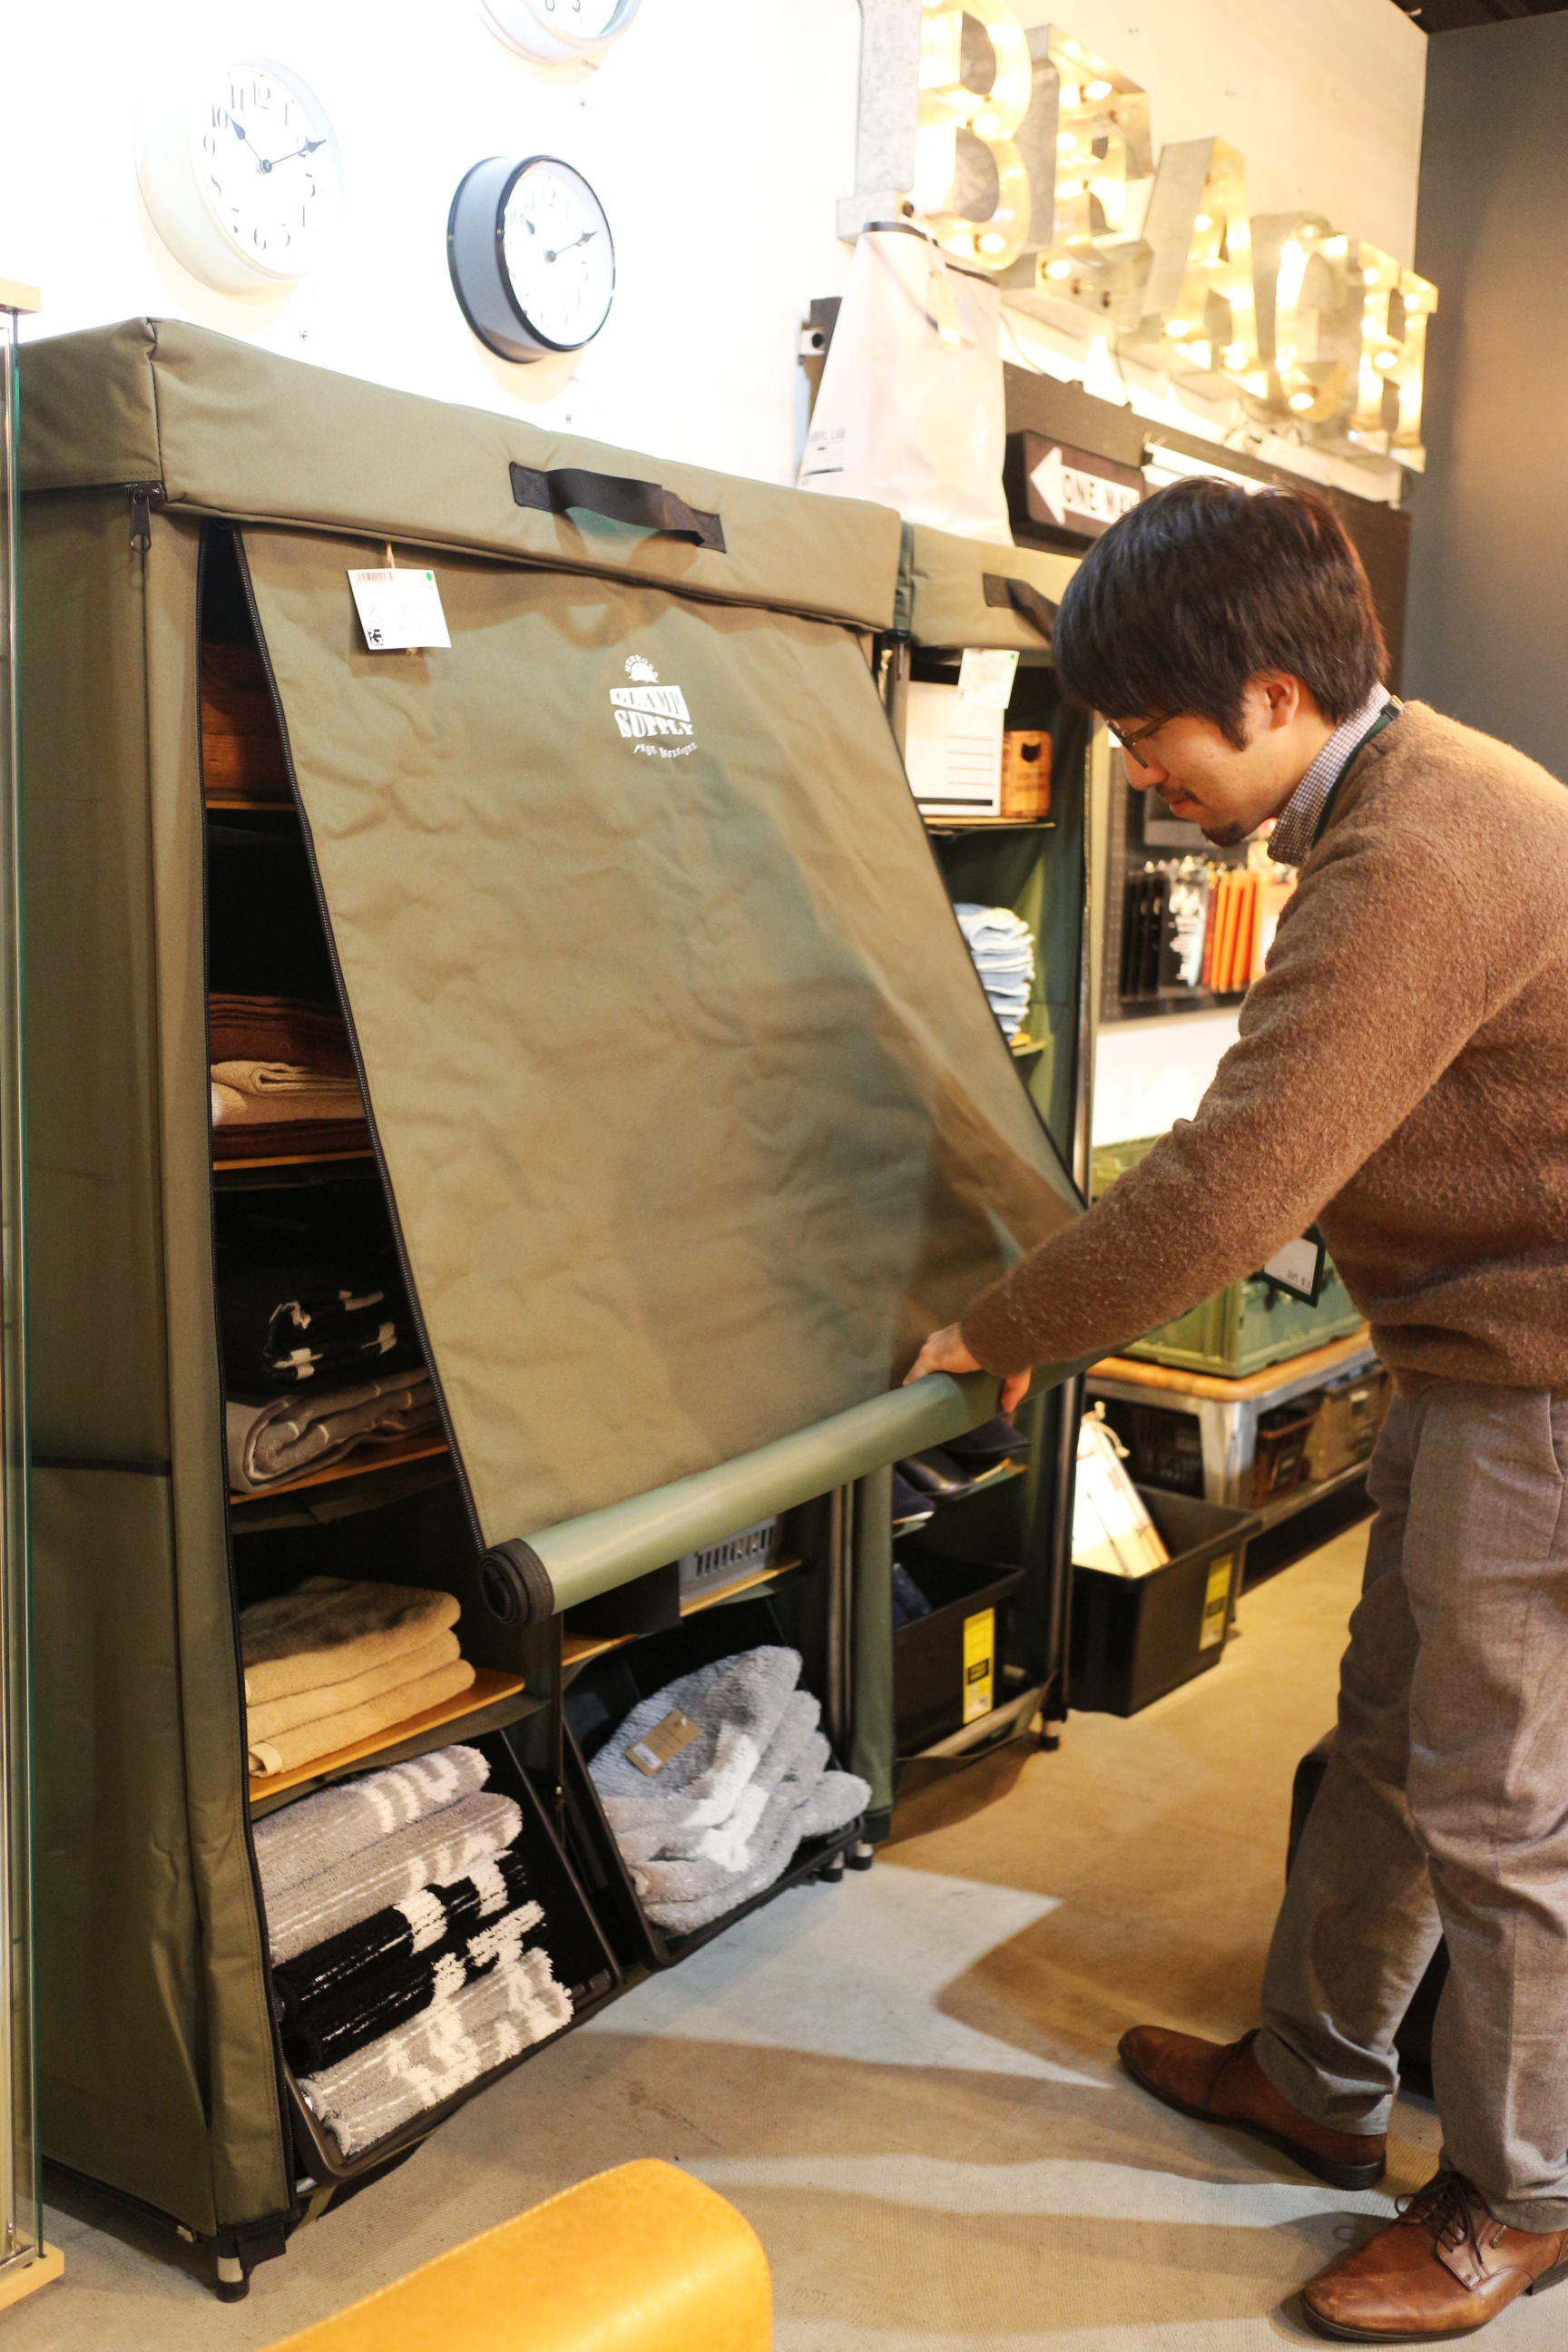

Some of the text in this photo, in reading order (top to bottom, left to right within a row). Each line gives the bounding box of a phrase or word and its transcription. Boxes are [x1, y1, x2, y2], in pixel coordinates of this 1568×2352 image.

[230, 84, 244, 113] 11
[252, 82, 271, 111] 12
[211, 102, 229, 131] 10
[202, 134, 216, 158] 9
[252, 225, 267, 250] 6
[839, 0, 1438, 474] BEACH
[1062, 473, 1096, 511] ONE
[615, 690, 681, 715] GLAMP
[614, 709, 694, 739] SUPPLY
